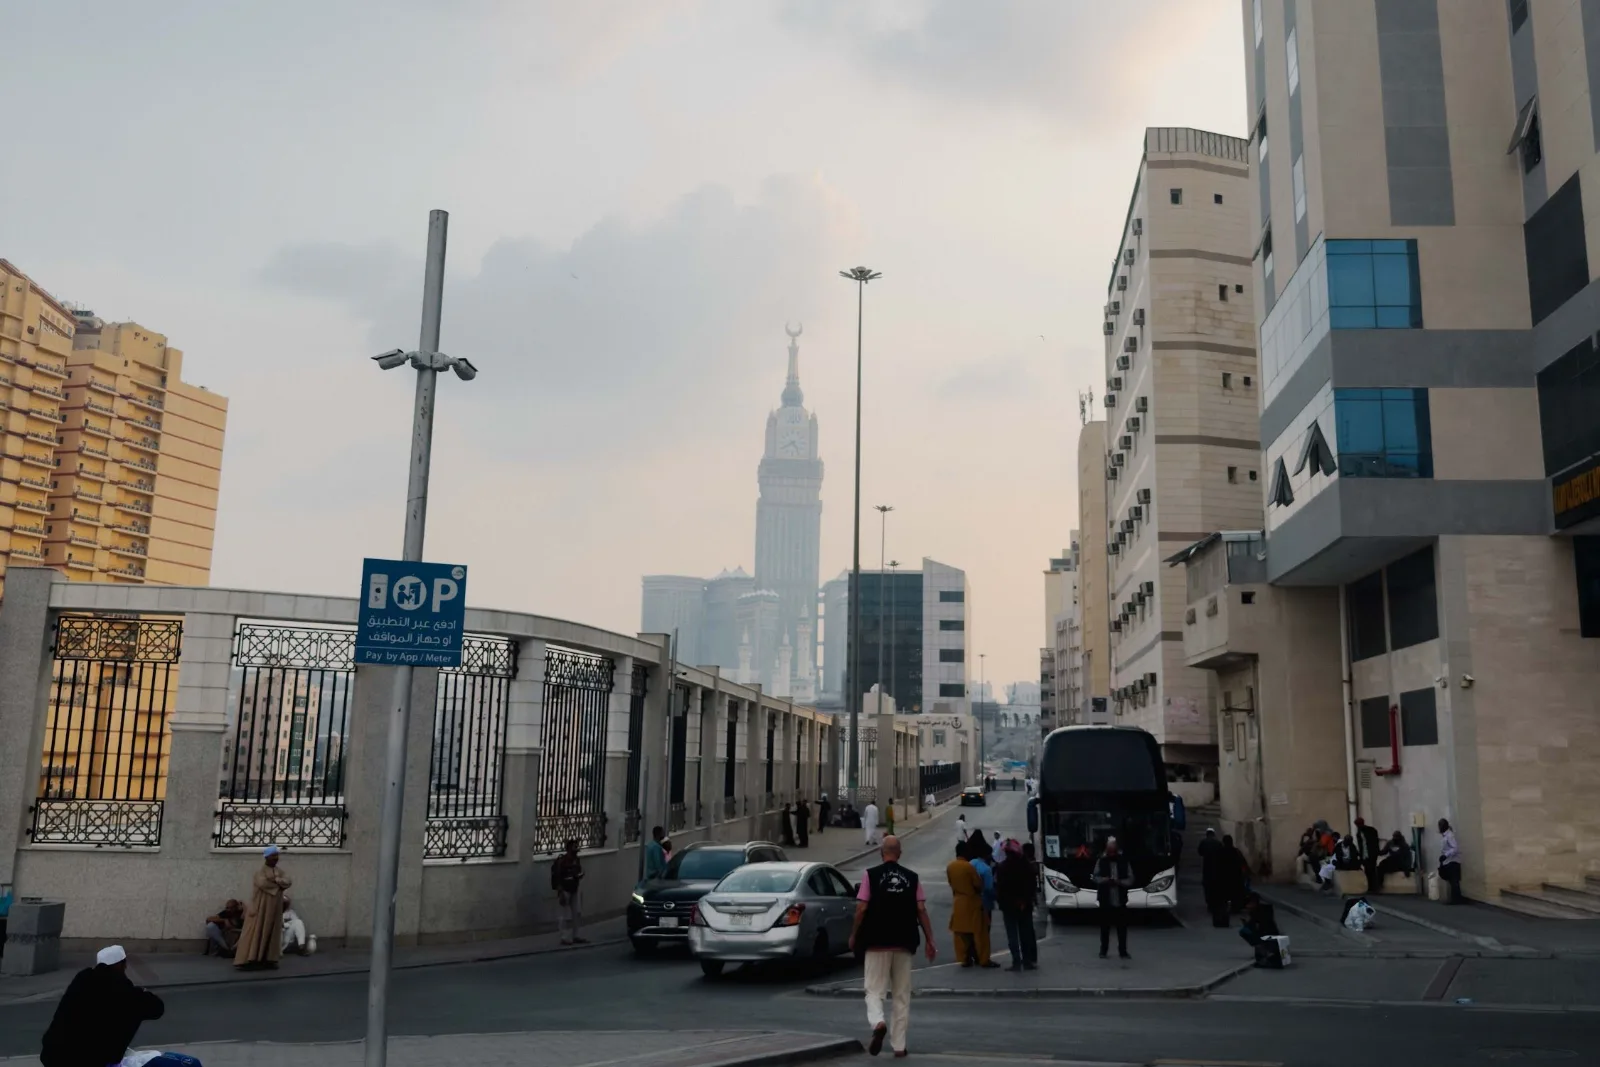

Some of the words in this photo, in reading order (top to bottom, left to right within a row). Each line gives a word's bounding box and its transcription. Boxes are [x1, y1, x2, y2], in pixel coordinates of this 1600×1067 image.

[432, 578, 458, 612] P
[367, 615, 410, 628] التطبيق
[411, 619, 430, 629] عبر
[433, 620, 456, 631] ادفع
[369, 631, 412, 643] المواقف
[414, 633, 440, 646] جهاز
[442, 635, 451, 646] او
[366, 651, 382, 661] Pay
[387, 652, 398, 662] by
[400, 652, 418, 662] App
[425, 653, 452, 662] Meter
